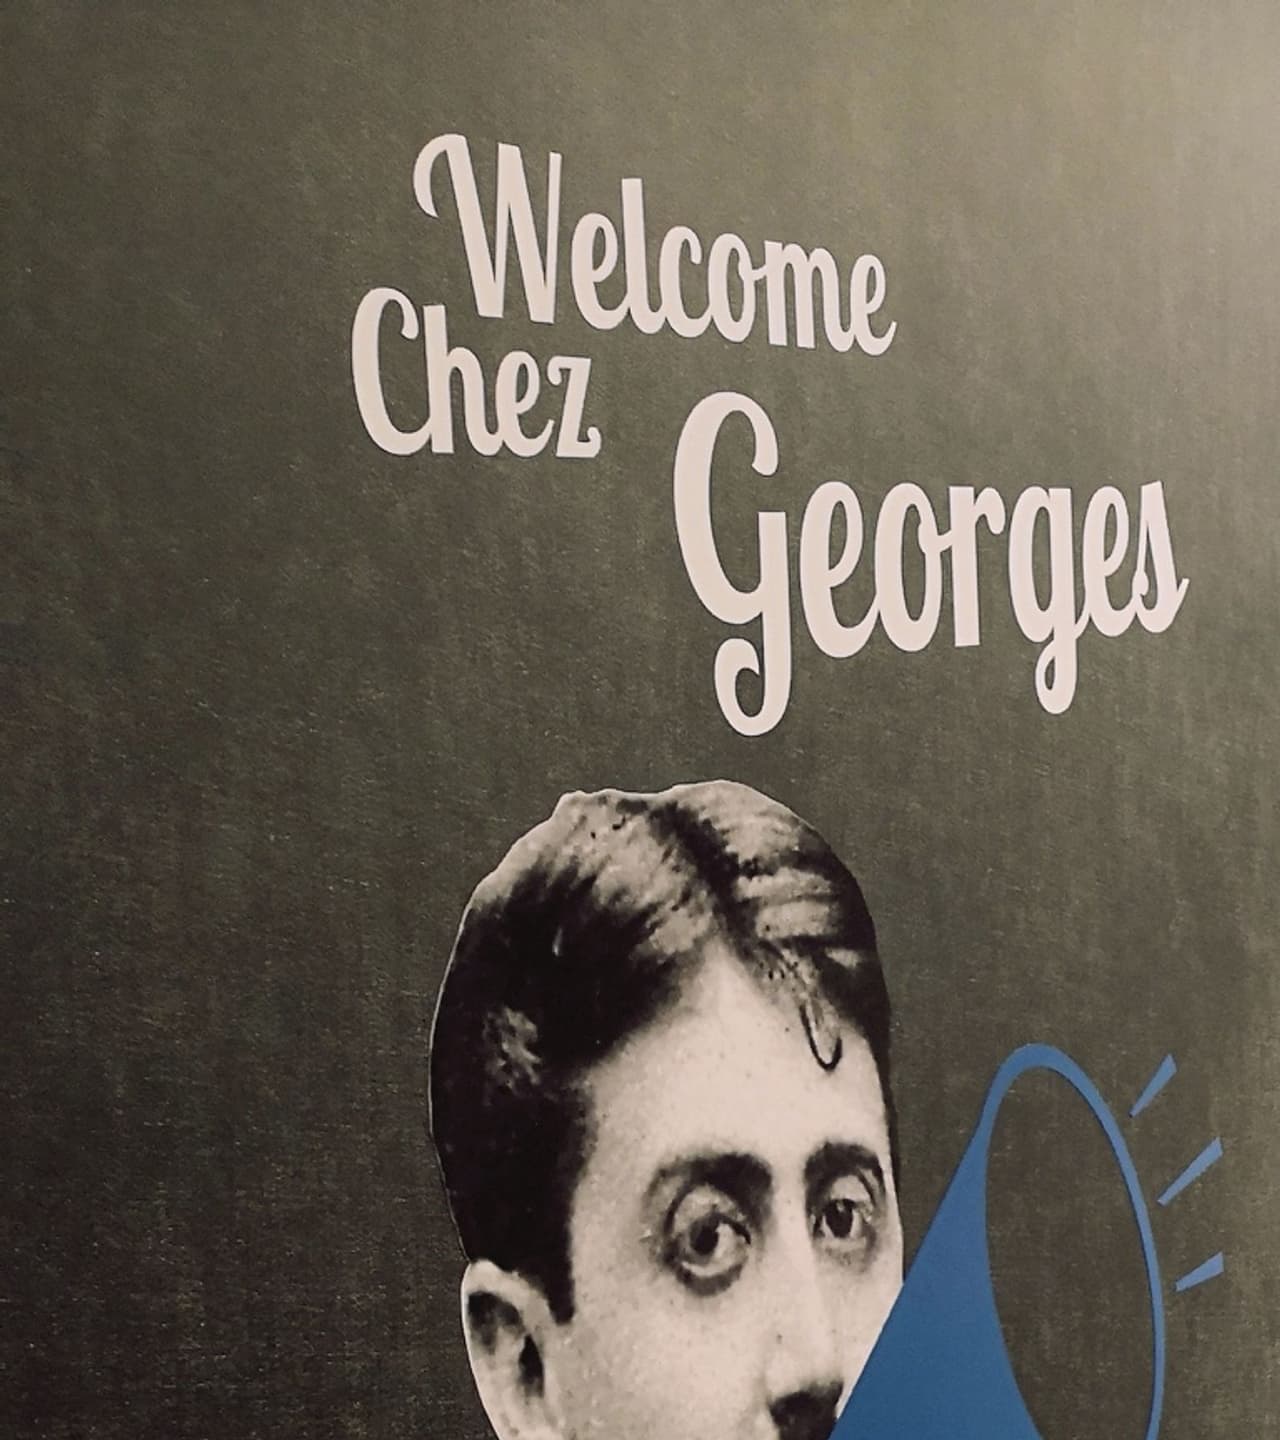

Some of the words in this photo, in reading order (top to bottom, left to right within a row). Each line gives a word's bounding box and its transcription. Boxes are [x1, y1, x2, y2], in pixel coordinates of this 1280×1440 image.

[413, 133, 898, 356] Welcome
[352, 287, 602, 458] Chez
[673, 391, 1190, 736] Georges
